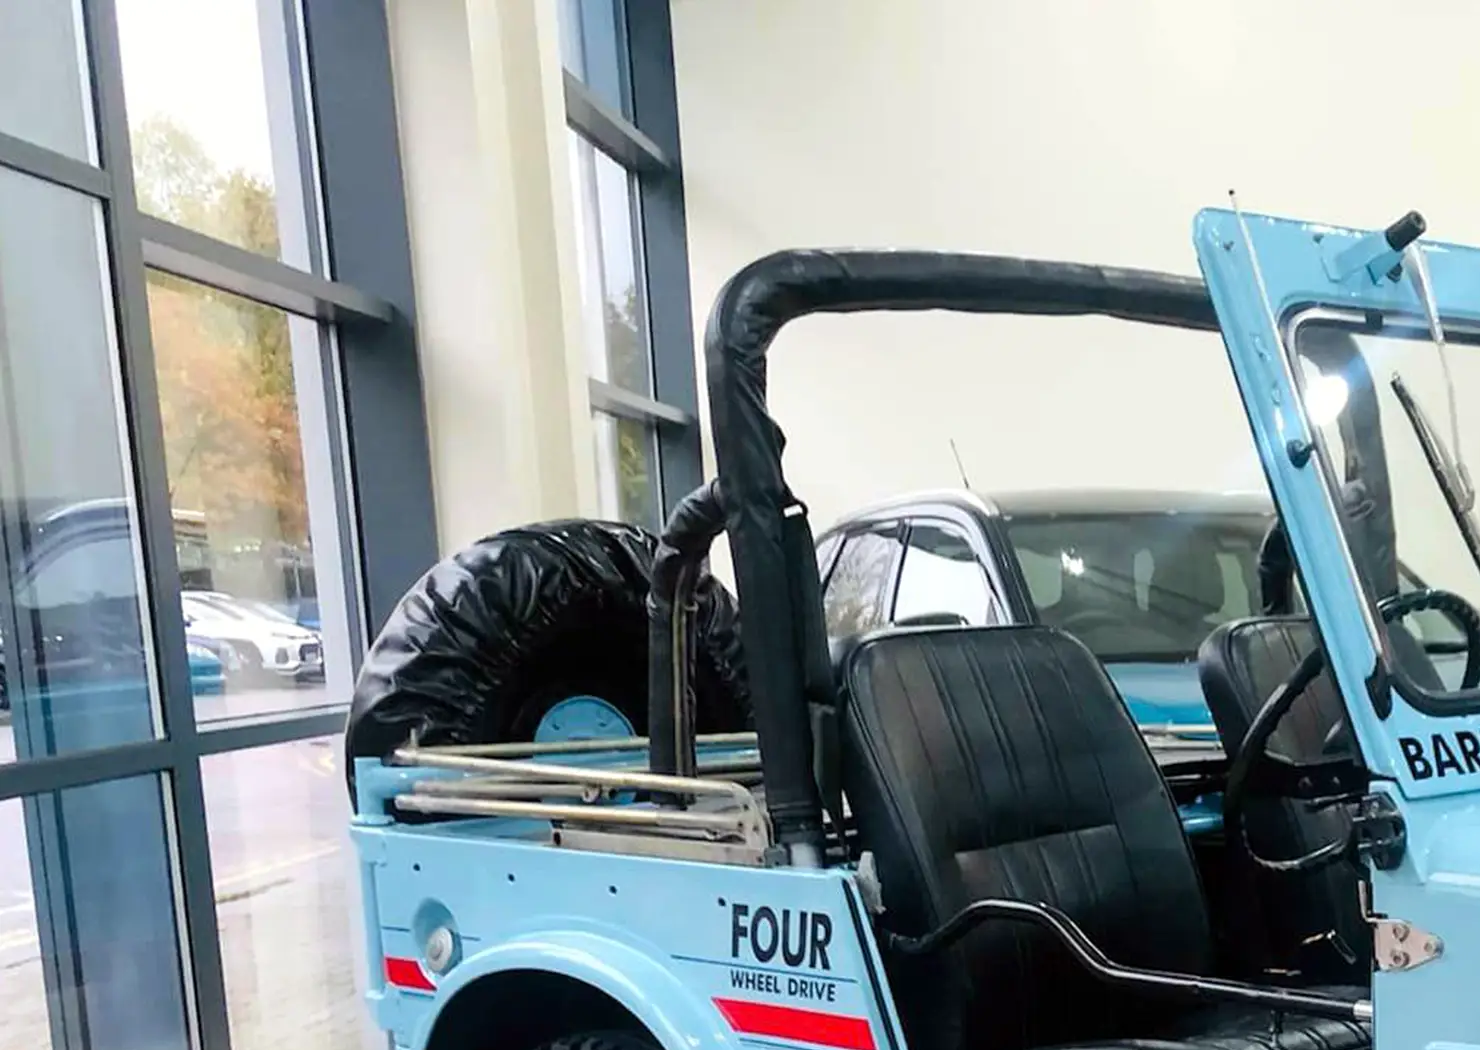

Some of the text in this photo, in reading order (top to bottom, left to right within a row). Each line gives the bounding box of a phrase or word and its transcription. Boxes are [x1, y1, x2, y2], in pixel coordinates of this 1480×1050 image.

[730, 903, 833, 970] FOUR
[730, 970, 837, 1001] WHEEL DRIVE
